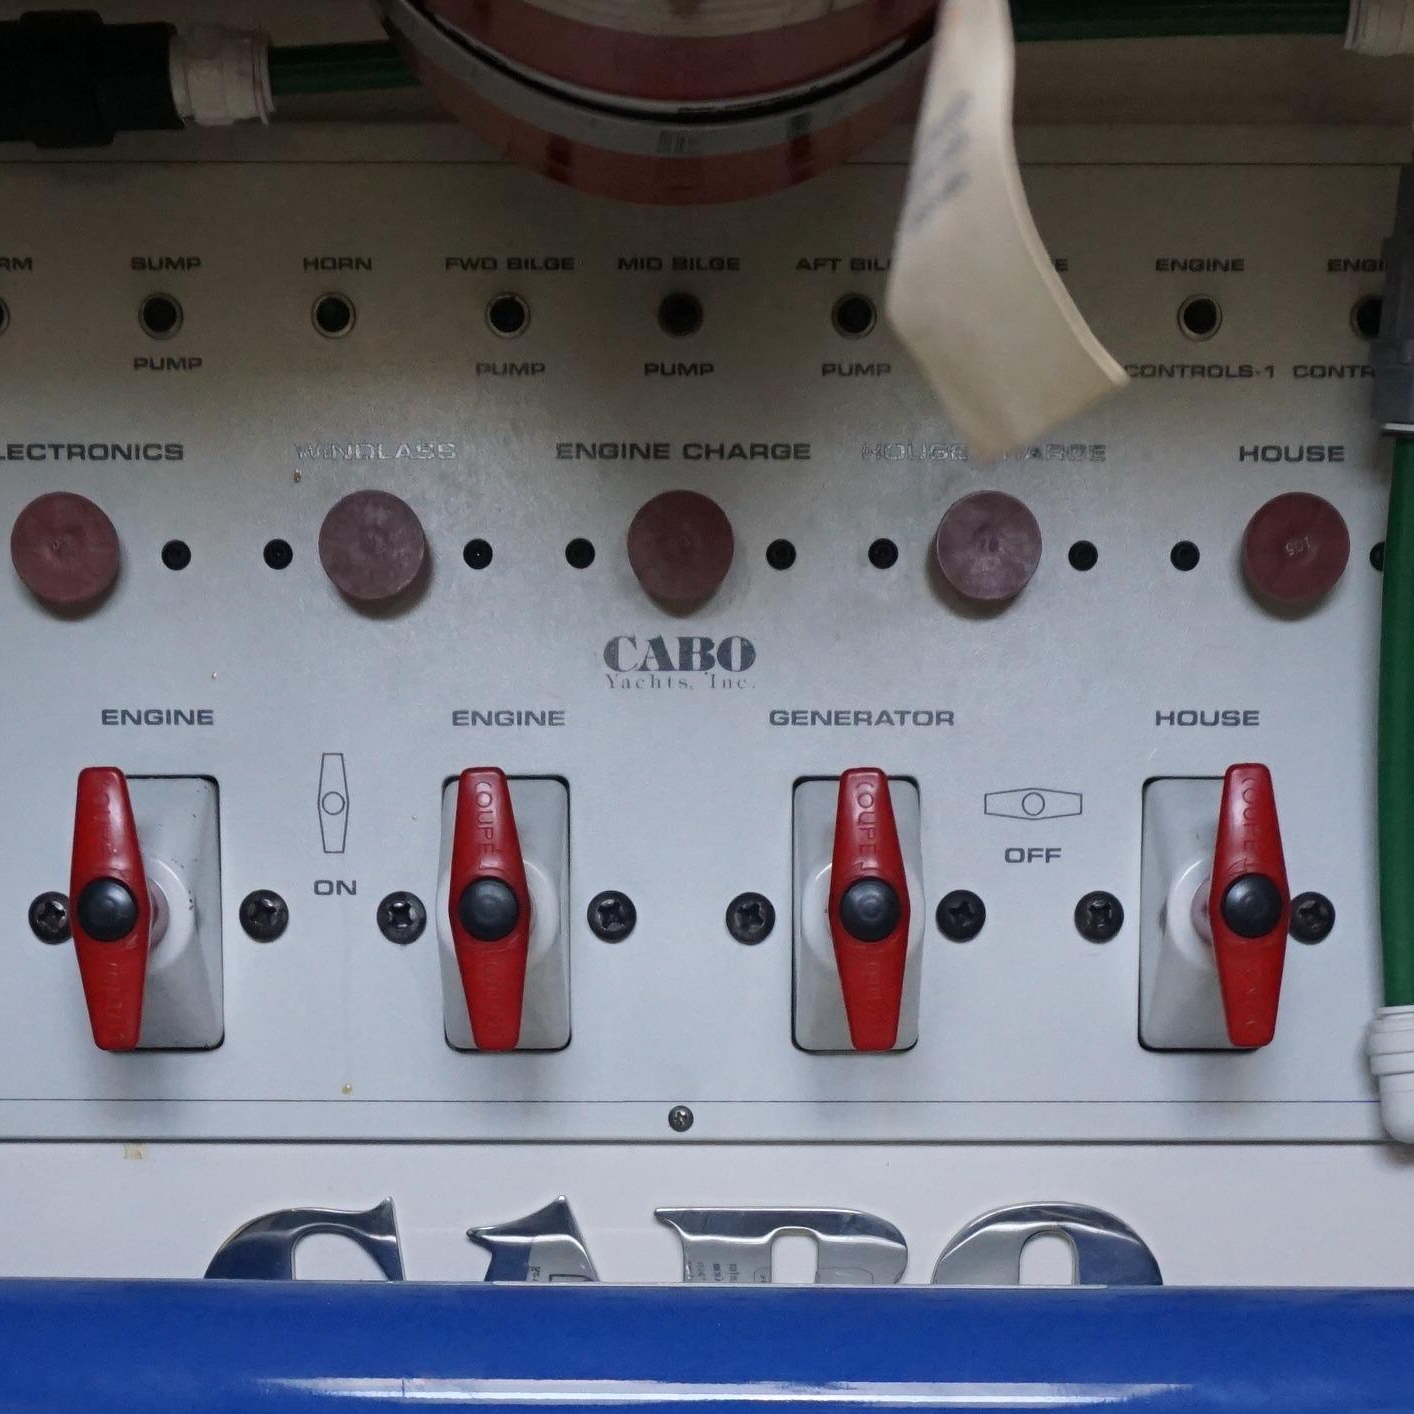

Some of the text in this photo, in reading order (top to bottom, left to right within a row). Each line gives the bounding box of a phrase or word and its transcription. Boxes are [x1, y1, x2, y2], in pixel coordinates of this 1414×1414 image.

[130, 256, 202, 271] SUMP
[303, 256, 373, 271] HORN
[445, 257, 575, 271] FWD BILGE
[617, 256, 740, 272] MID BILGE
[795, 257, 891, 272] AFT BIL
[1155, 258, 1244, 273] ENGINE
[1326, 258, 1384, 273] ENGI
[133, 357, 203, 371] PUMP
[475, 362, 546, 377] PUMP
[644, 362, 715, 377] PUMP
[821, 363, 892, 377] PUMP
[1124, 364, 1275, 379] CONTROLS-1
[294, 442, 458, 461] WINDLASS
[555, 442, 811, 461] ENGINE CHARGE
[1239, 445, 1345, 463] HOUSE
[603, 636, 757, 672] CABO
[605, 673, 757, 691] Yachts, Inc.
[101, 709, 214, 726] ENGINE
[451, 709, 565, 727] ENGINE
[769, 709, 955, 727] GENERATOR
[1155, 710, 1260, 727] HOUSE
[1004, 847, 1062, 864] OFF
[313, 879, 357, 896] ON
